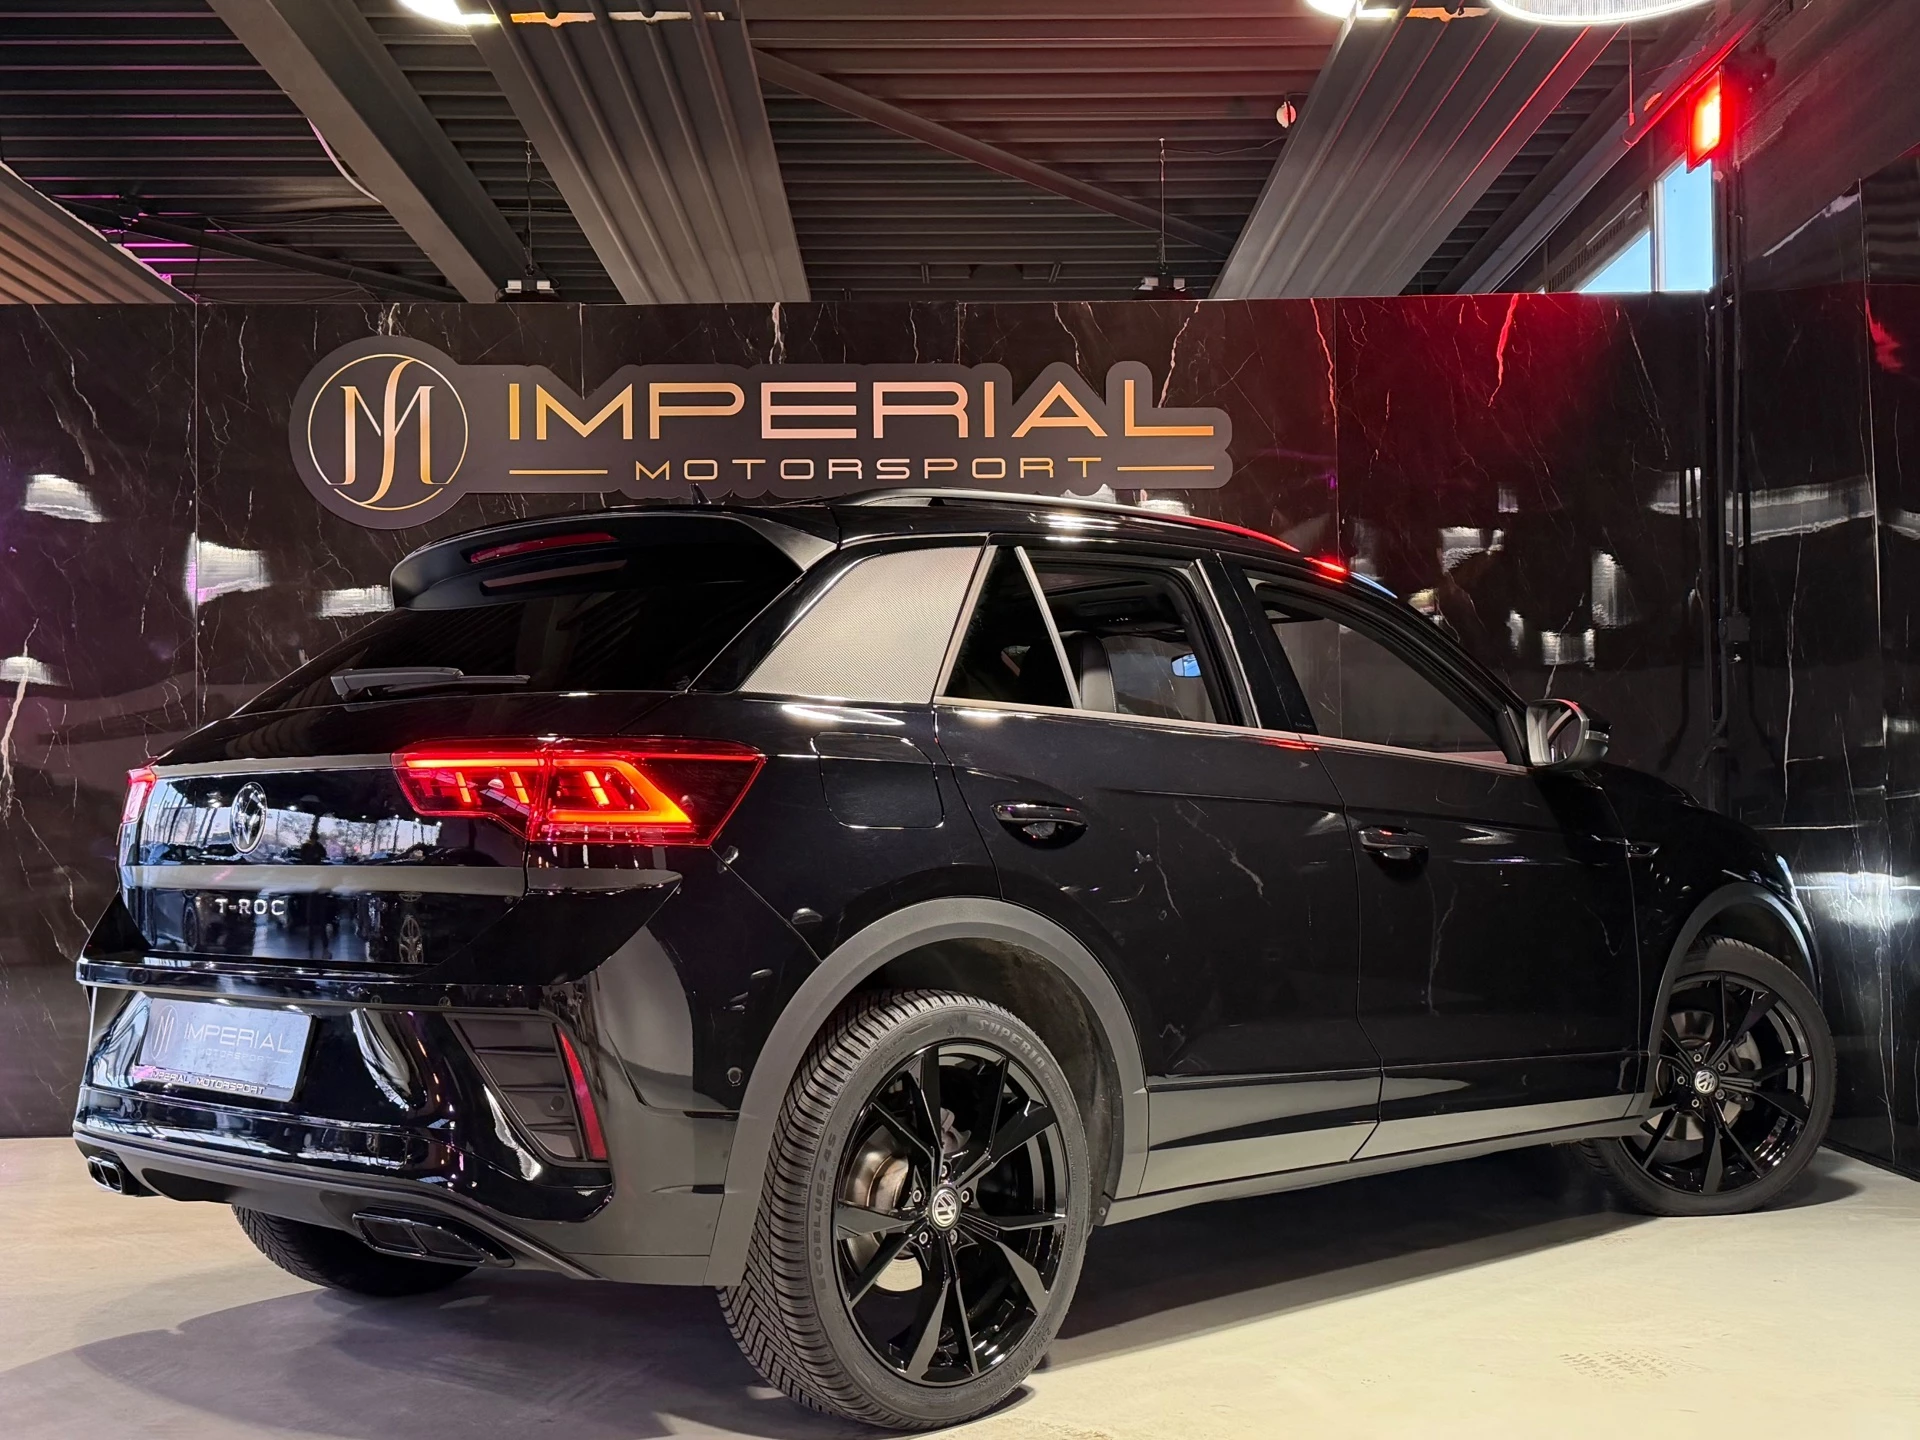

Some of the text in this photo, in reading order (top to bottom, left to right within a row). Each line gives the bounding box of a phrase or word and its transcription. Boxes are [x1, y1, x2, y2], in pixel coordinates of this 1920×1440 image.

[508, 380, 1215, 441] IMPERIAL
[635, 455, 1104, 482] MOTORSPORT
[214, 898, 285, 916] T-ROC
[183, 1021, 294, 1054] IMPERIAL
[977, 1019, 1046, 1070] SUPERIA
[200, 1047, 274, 1062] MOTORSPORT
[195, 1077, 267, 1095] MOTORSPORT
